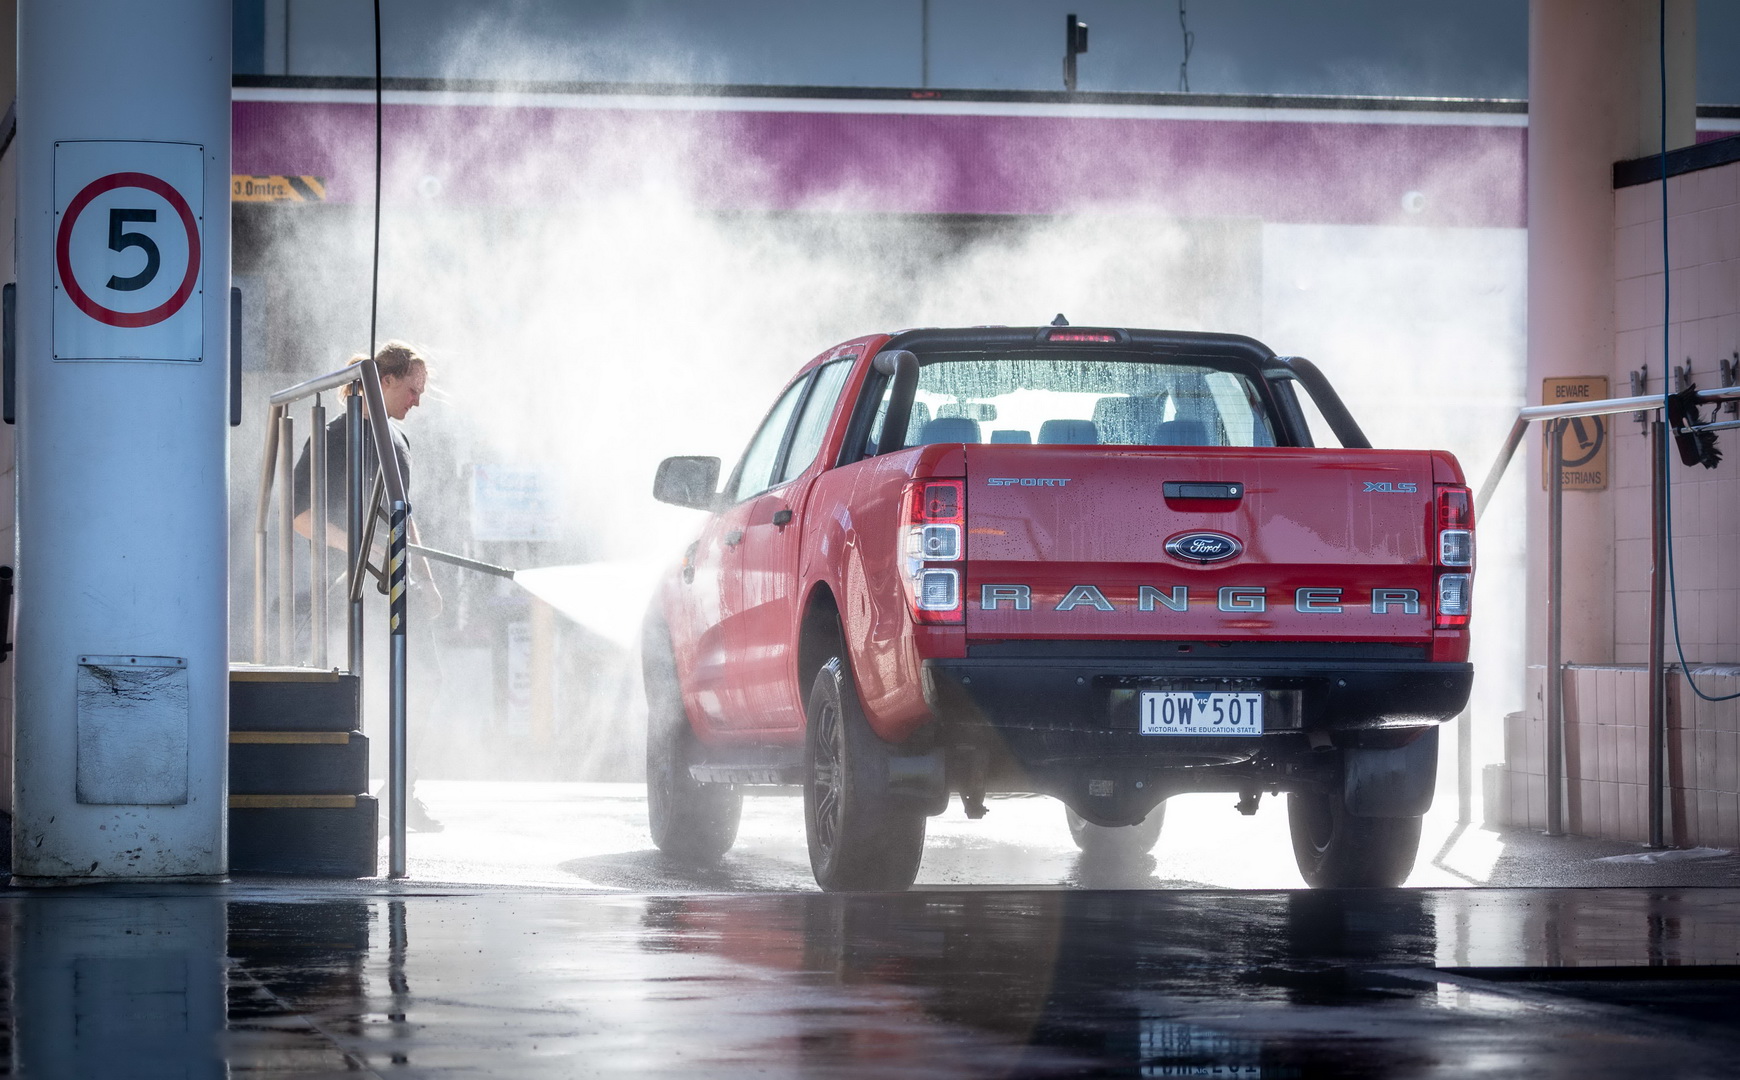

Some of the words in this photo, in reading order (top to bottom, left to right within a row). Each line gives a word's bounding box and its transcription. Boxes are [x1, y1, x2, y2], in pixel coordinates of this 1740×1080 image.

[105, 208, 161, 292] 5
[1555, 385, 1589, 398] BEWARE
[987, 477, 1072, 487] SPORT
[1547, 471, 1601, 484] ESTRIANS
[1363, 482, 1417, 493] XLS
[1189, 538, 1222, 554] Ford
[981, 584, 1421, 614] RANGER
